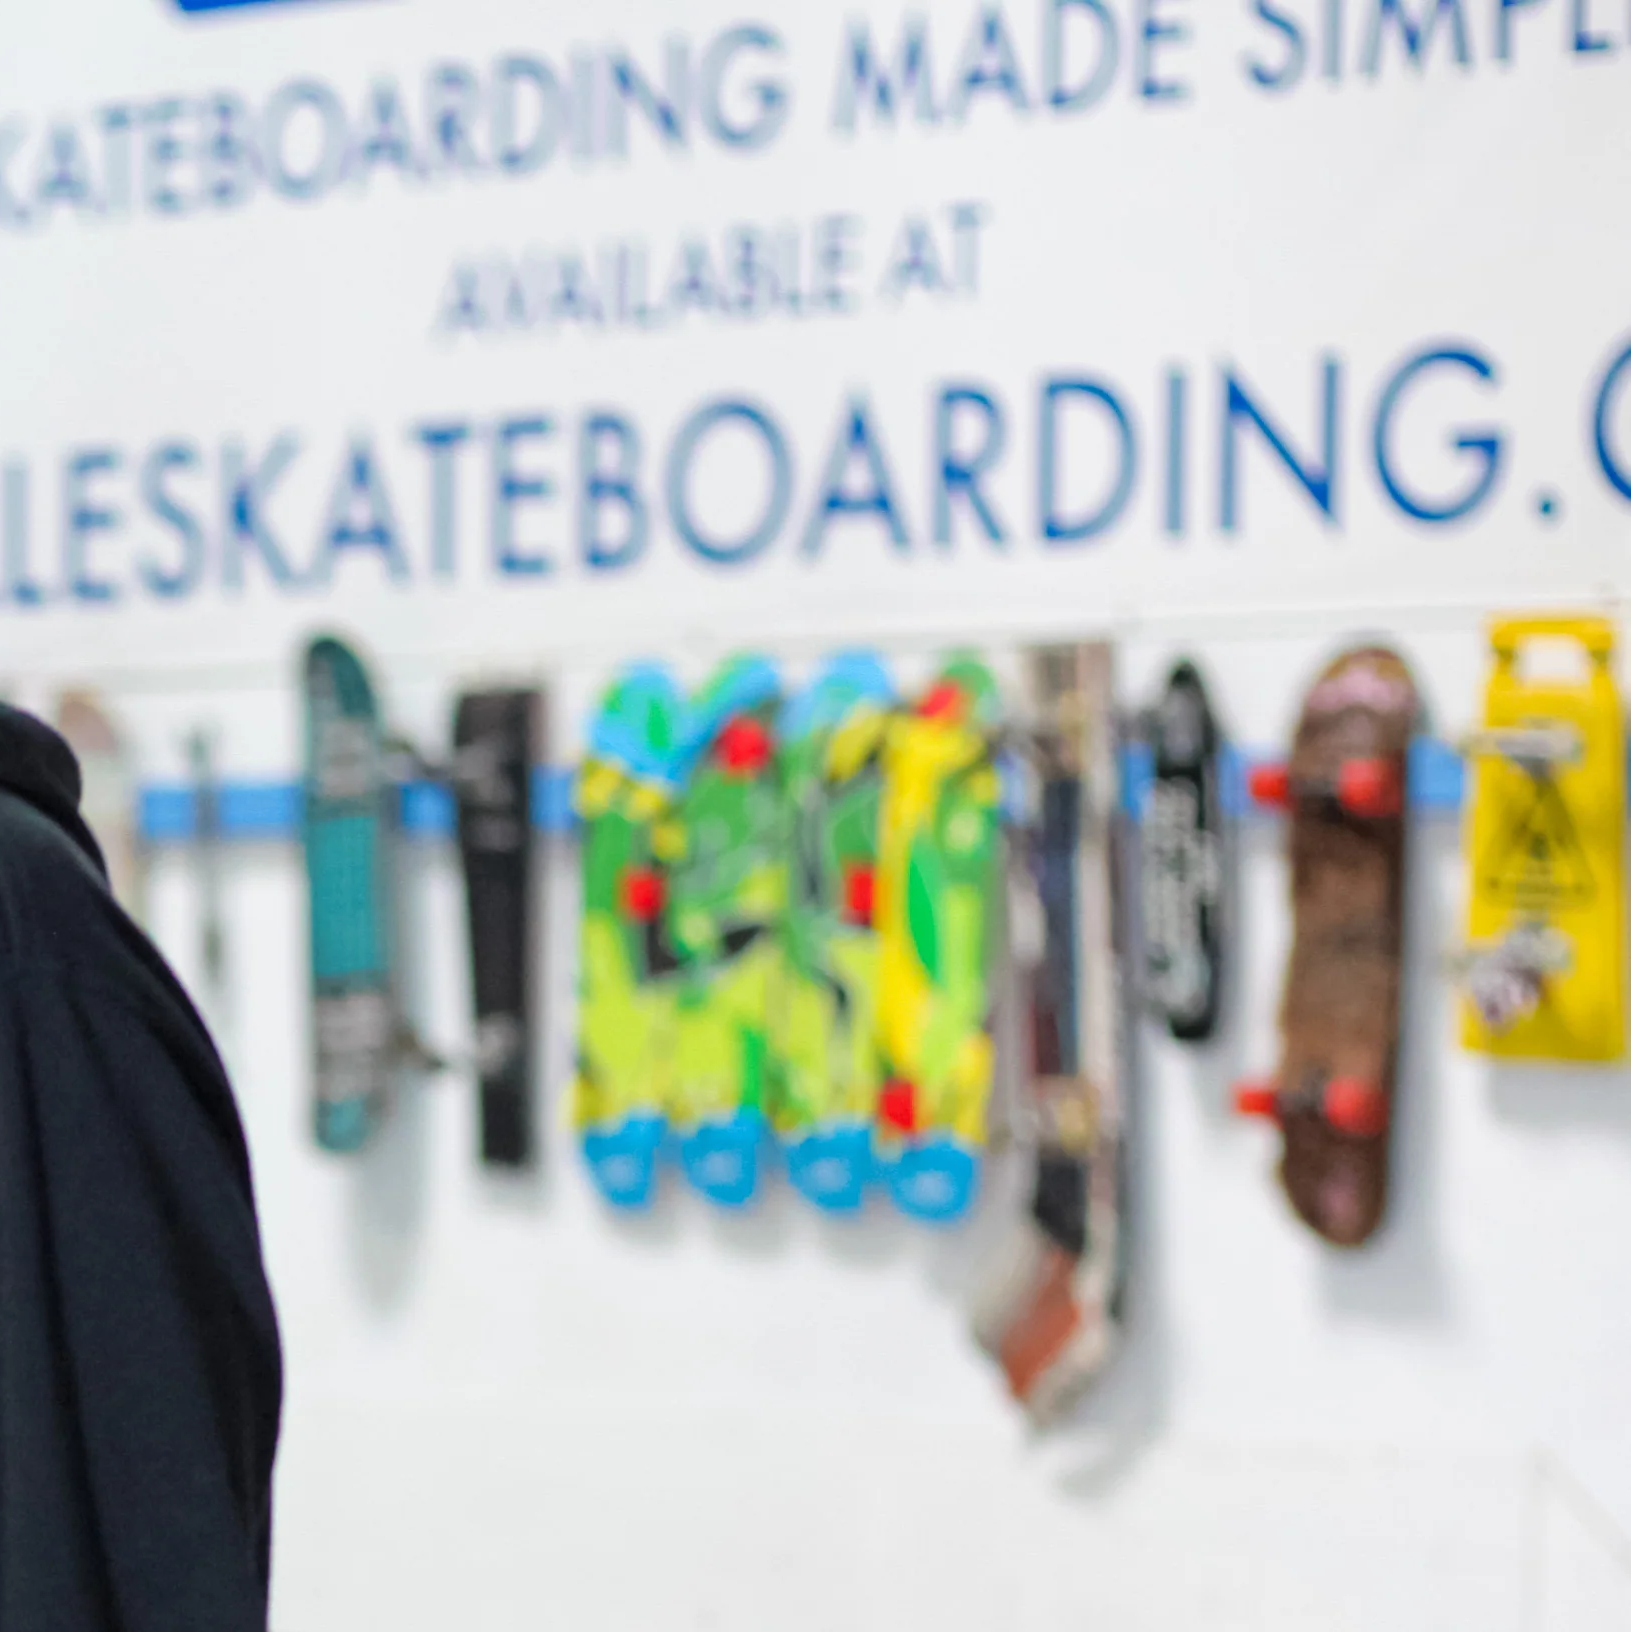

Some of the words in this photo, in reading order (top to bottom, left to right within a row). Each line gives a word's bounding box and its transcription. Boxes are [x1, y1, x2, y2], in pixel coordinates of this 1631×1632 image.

[829, 0, 1193, 135] MADE
[1241, 0, 1631, 95] SIMPL
[430, 208, 864, 338] AVAILABLE
[879, 200, 991, 300] AT
